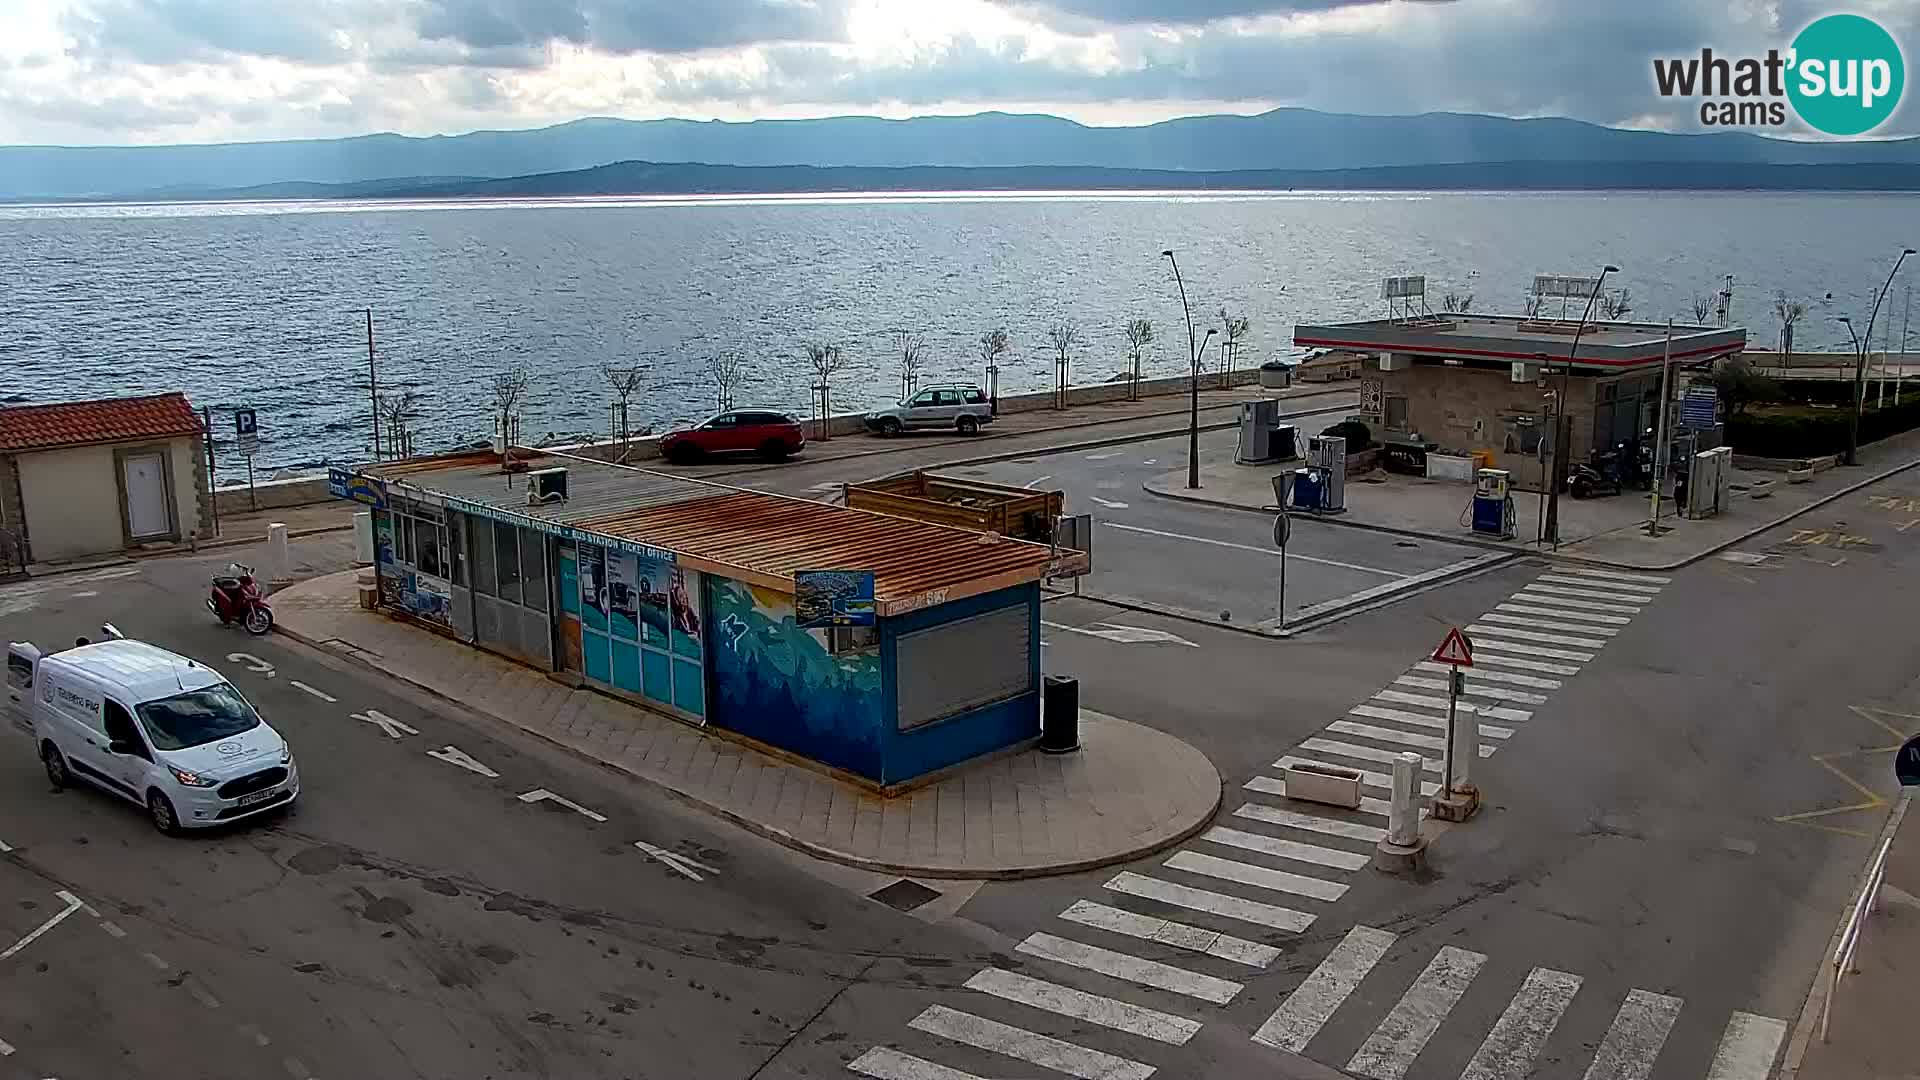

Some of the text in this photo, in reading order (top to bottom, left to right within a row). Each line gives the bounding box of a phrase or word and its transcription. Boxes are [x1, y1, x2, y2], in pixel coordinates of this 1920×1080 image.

[240, 413, 251, 431] P
[572, 528, 587, 542] BUS
[587, 533, 619, 550] STATION
[620, 541, 646, 558] TICKET
[646, 547, 674, 563] OFFICE
